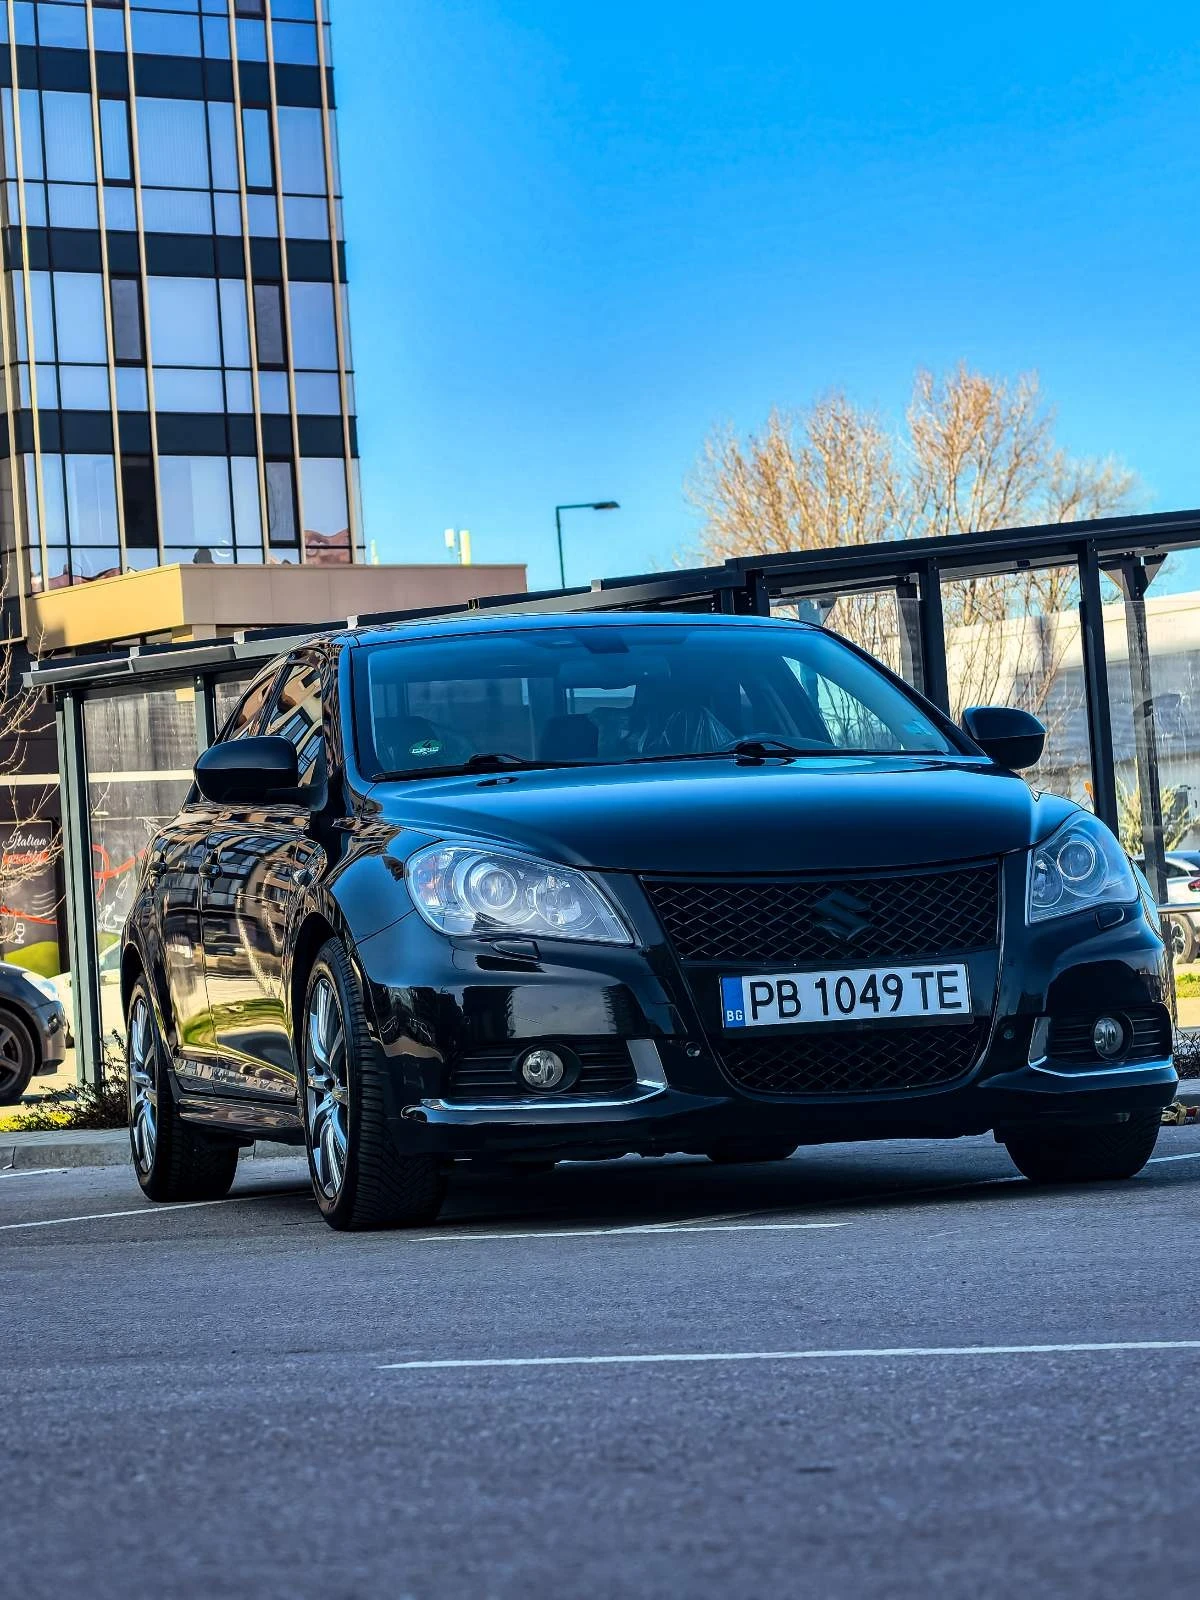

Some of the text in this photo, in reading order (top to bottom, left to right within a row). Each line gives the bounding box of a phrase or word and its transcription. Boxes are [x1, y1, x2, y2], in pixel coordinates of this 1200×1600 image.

[2, 831, 47, 850] Italian
[749, 970, 962, 1021] PB 1049 TE
[727, 1010, 743, 1022] BG
